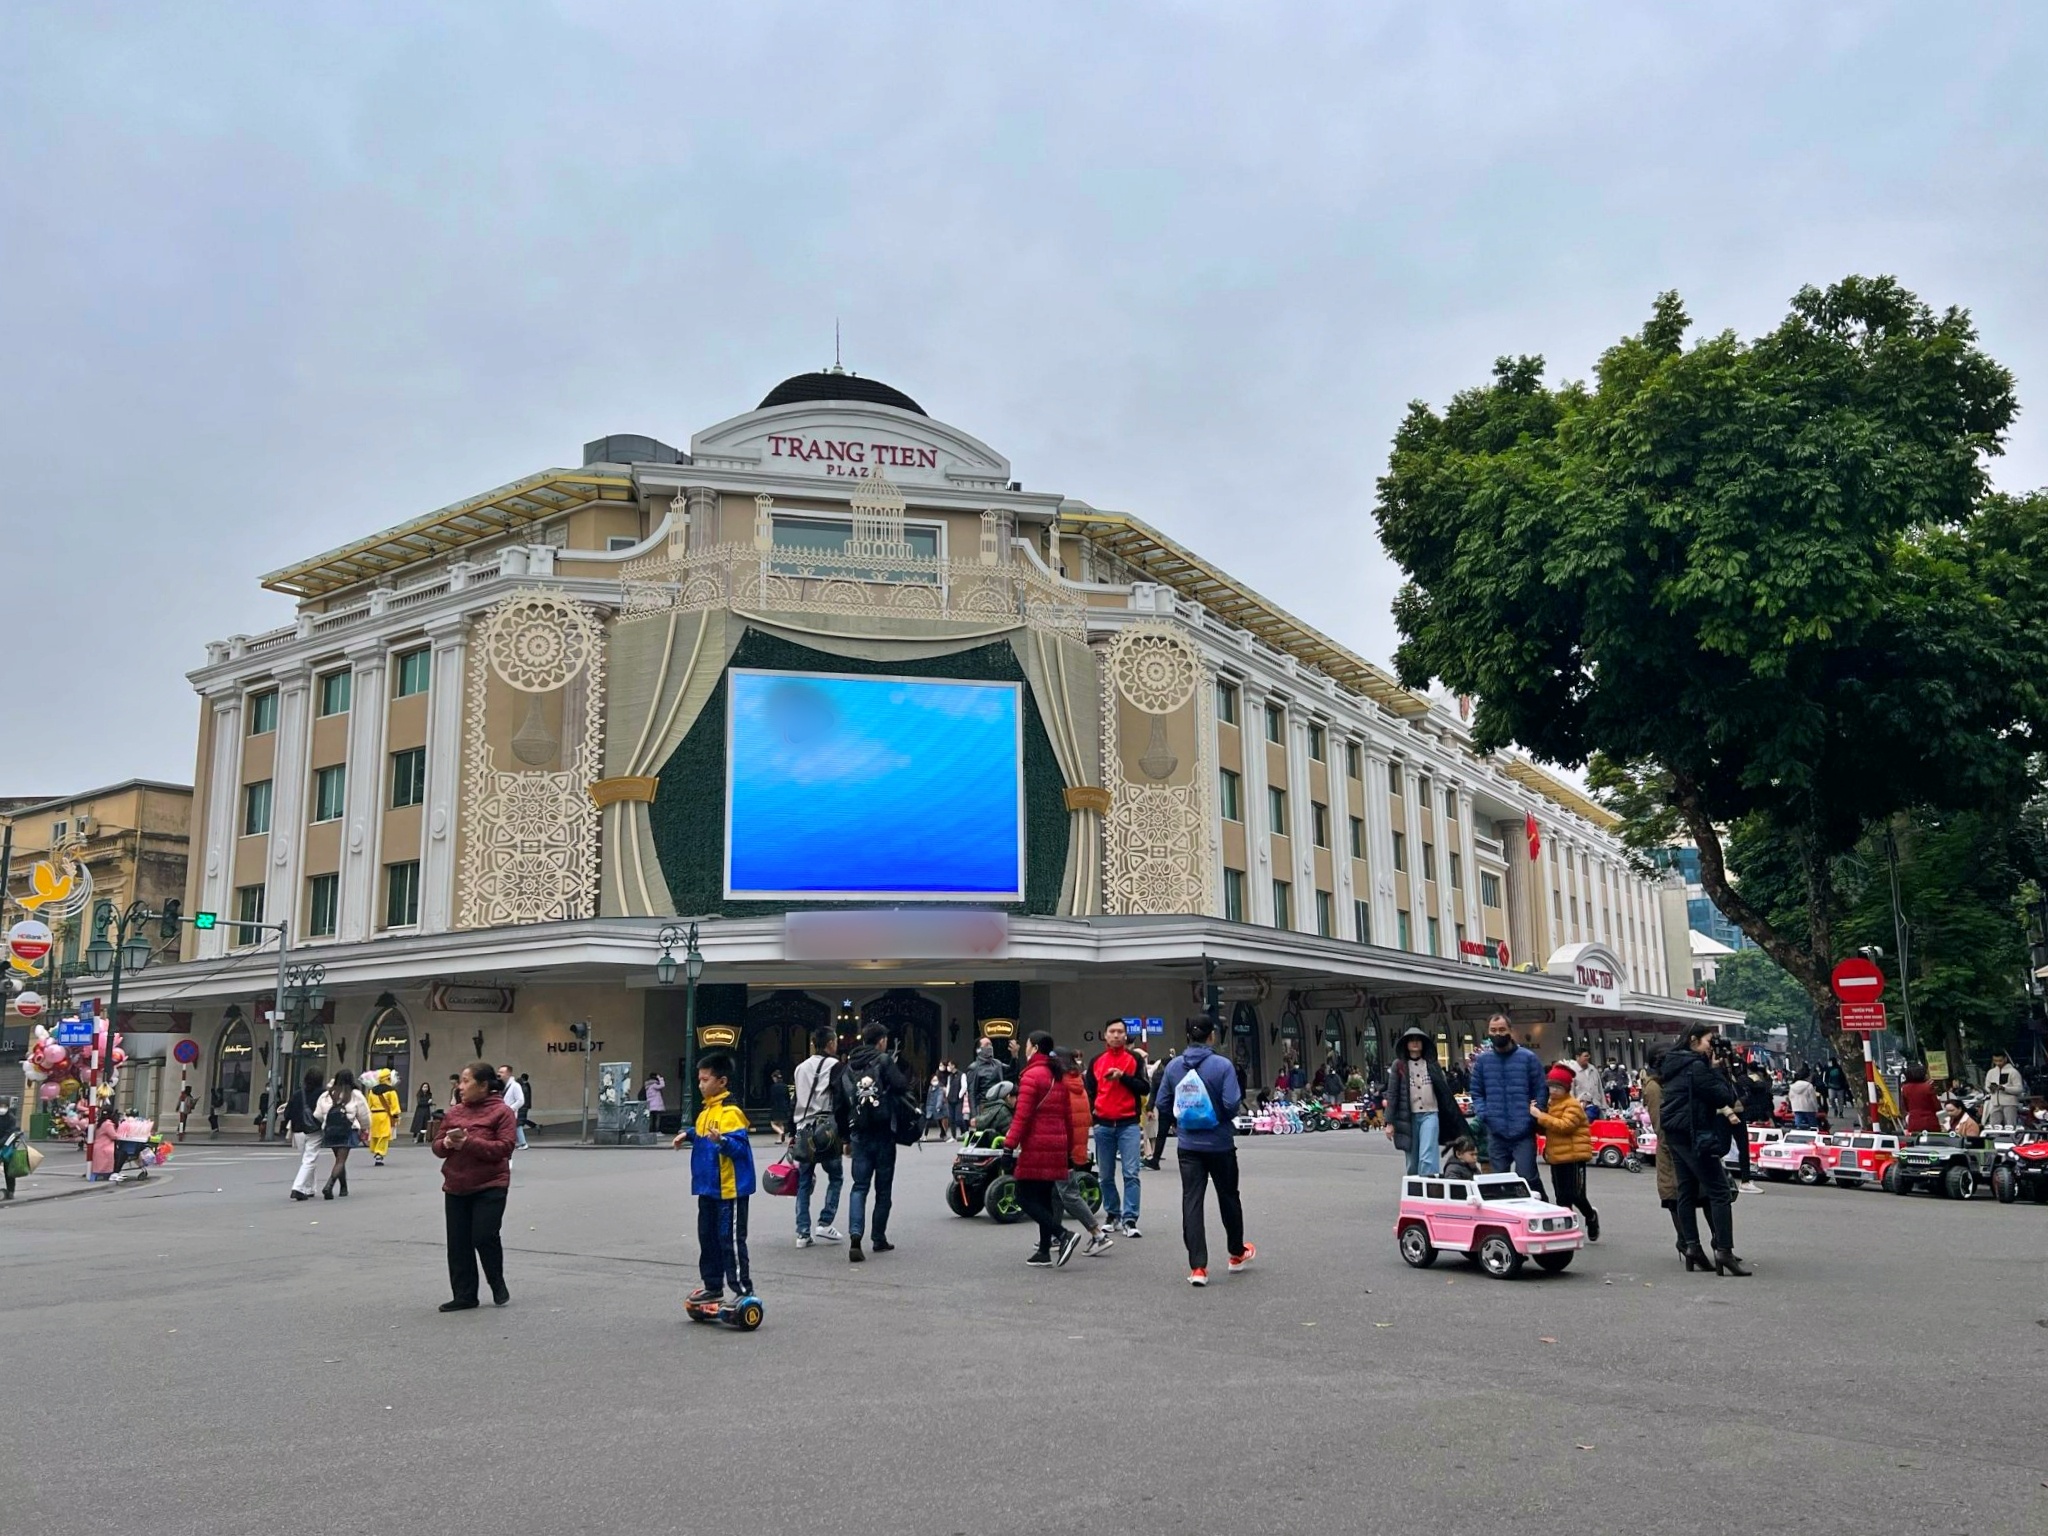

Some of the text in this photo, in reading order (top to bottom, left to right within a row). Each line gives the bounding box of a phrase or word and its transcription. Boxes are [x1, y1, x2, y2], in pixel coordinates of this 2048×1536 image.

[768, 435, 938, 469] TRANG TIEN
[826, 464, 883, 478] PLAZ
[1576, 964, 1614, 990] TRANG TIEN
[547, 1041, 604, 1053] HUBLOT
